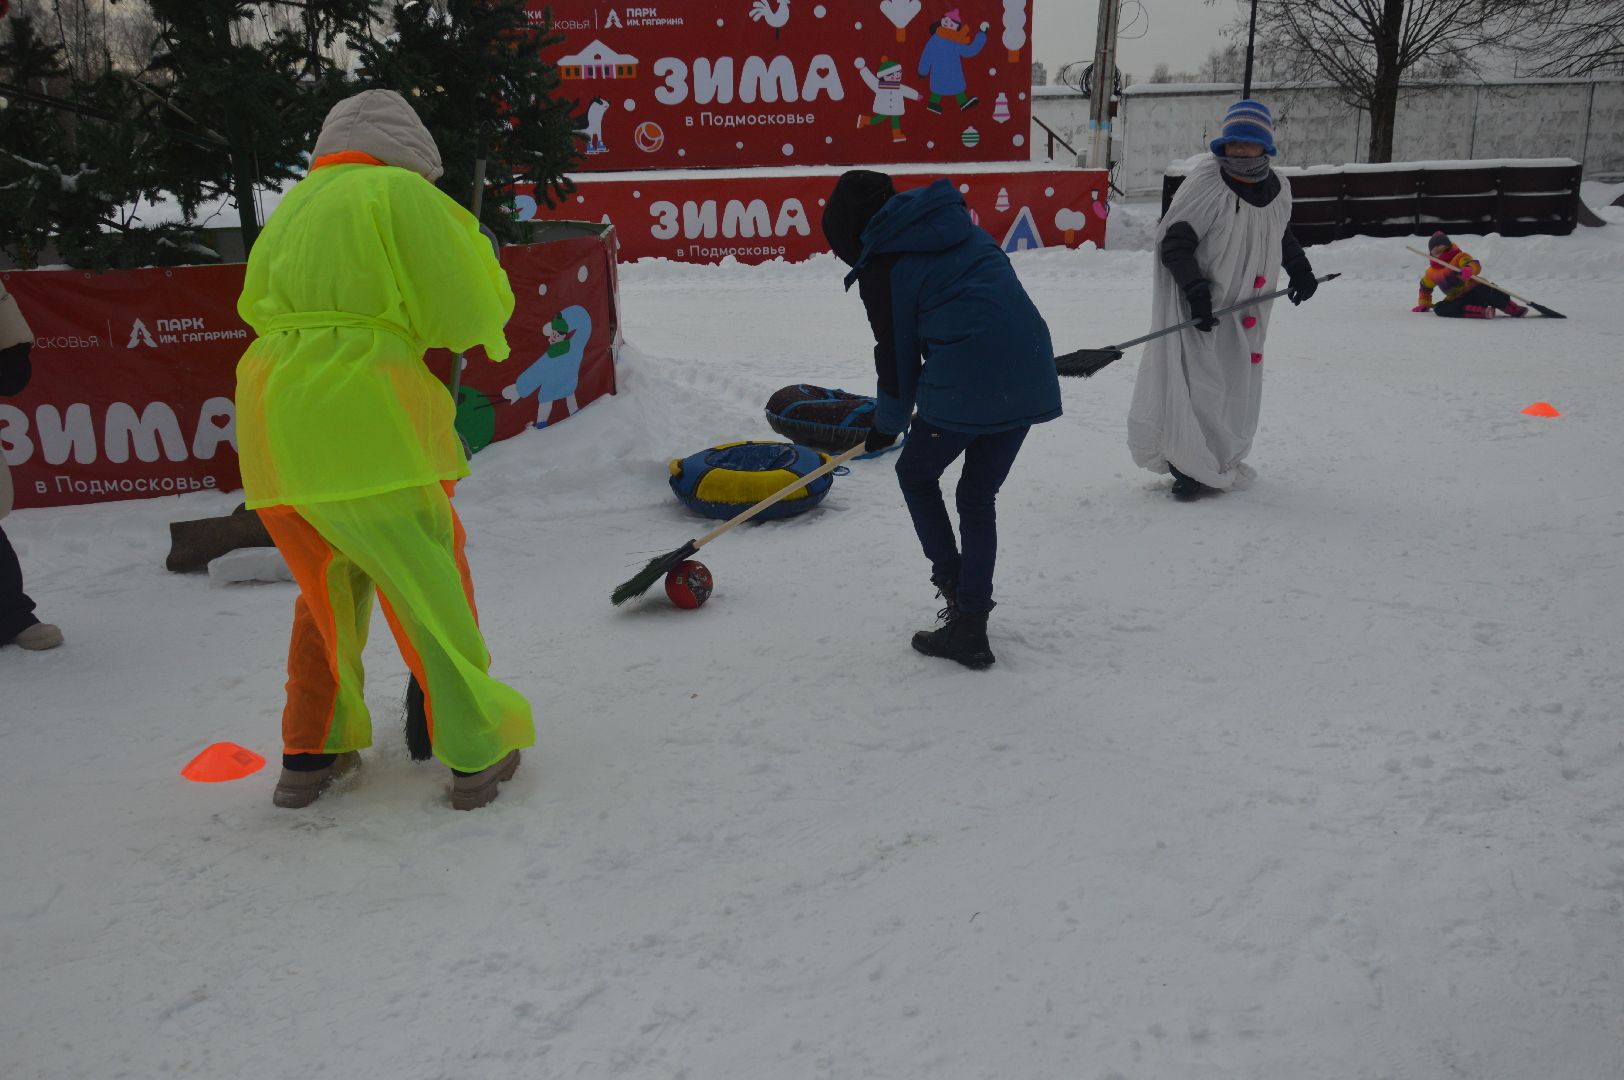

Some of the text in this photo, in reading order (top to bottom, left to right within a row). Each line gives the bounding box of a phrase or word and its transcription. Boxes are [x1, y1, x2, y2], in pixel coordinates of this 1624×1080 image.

[626, 8, 657, 18] ПАРК
[641, 17, 684, 26] ГАГАРИНА
[653, 53, 845, 106] ЗИМА
[685, 111, 815, 128] в Подмосковье
[649, 197, 811, 241] ЗИМА
[677, 245, 785, 258] в Подмосковье
[157, 317, 205, 332] ПАРК
[32, 335, 100, 349] СКОВЬЯ
[159, 329, 248, 344] ИМ. ГАГАРИНА
[0, 396, 239, 466] ЗИМА
[34, 474, 217, 495] в Подмосковье
